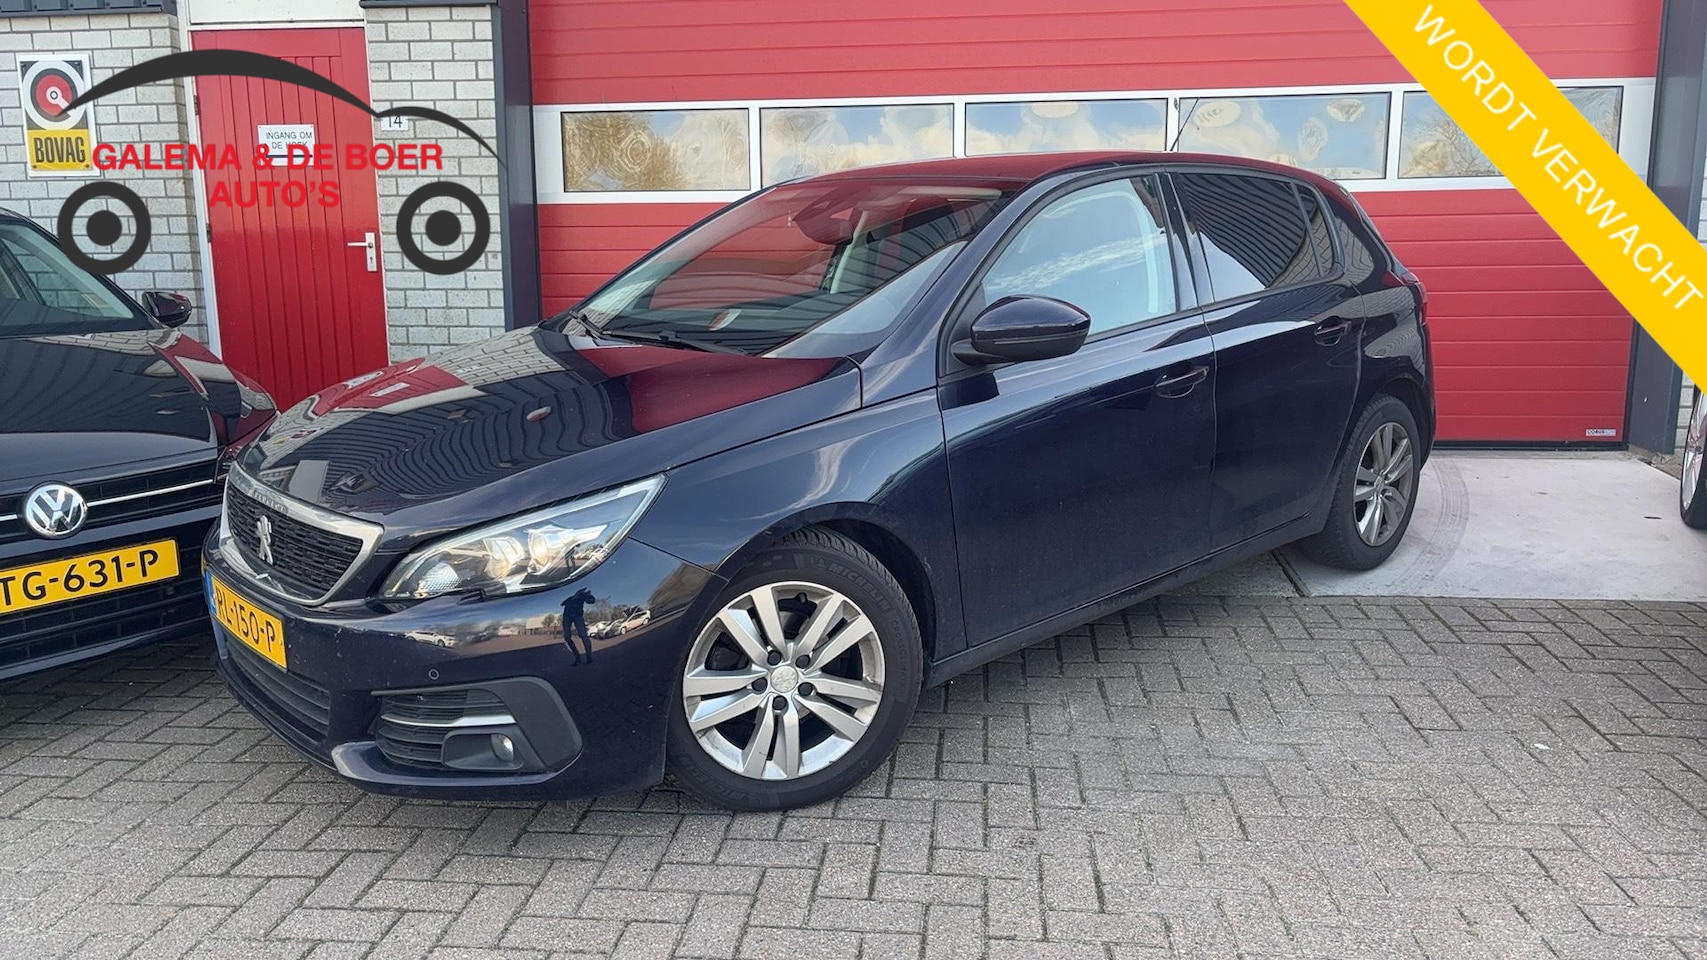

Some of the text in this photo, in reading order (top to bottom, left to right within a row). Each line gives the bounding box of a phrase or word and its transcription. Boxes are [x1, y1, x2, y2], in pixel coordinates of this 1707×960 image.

[33, 136, 86, 163] BOVAG
[266, 131, 312, 139] INGANG OM
[272, 141, 283, 150] DE
[0, 549, 159, 606] TG-631-P
[828, 562, 891, 613] MICHELIN
[215, 586, 276, 653] RL-150-P
